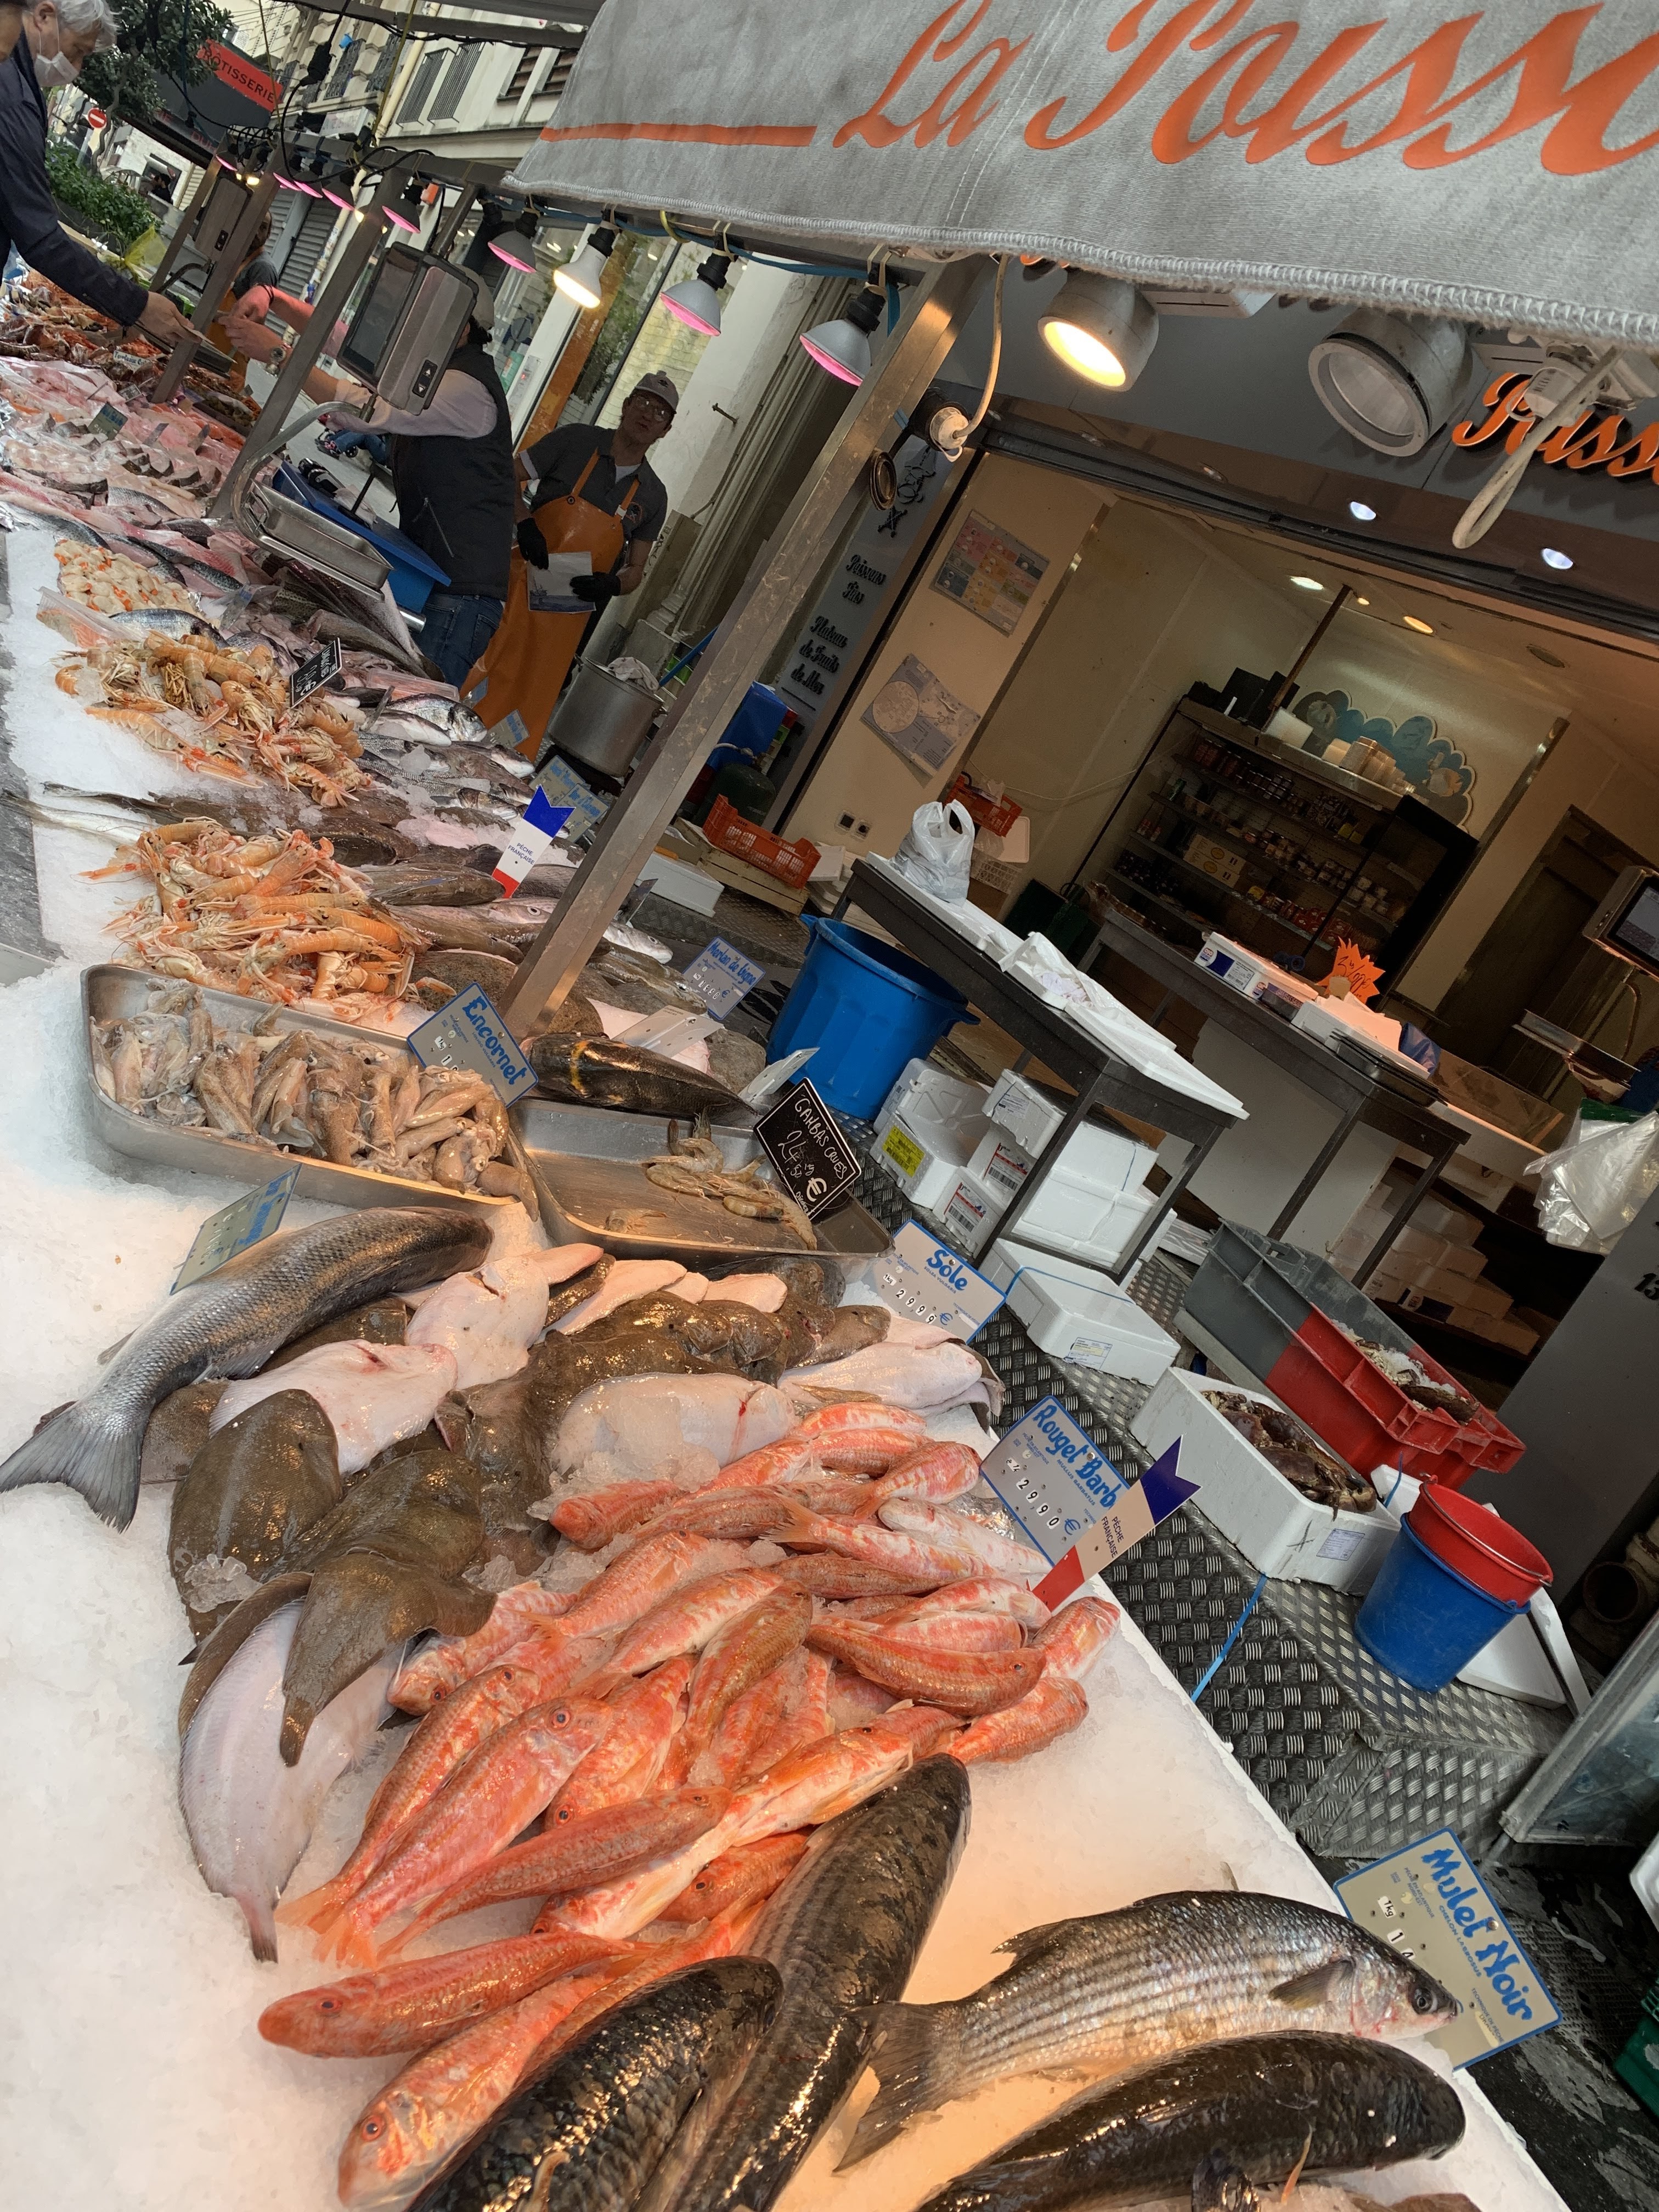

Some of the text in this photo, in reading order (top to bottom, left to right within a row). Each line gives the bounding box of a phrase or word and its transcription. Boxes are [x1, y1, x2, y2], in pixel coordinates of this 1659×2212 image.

[833, 0, 1034, 148] La
[847, 554, 887, 585] Poissons
[843, 581, 865, 604] Fins
[810, 616, 848, 648] Plateau
[799, 639, 839, 673] de Fruits
[791, 663, 825, 695] de Mer
[508, 845, 535, 865] FRANÇAISE
[517, 843, 533, 856] PÊCHE
[708, 941, 731, 966] Merlan
[729, 958, 741, 972] de
[722, 990, 730, 998] €
[462, 996, 527, 1085] Encornet
[795, 1098, 848, 1180] GAMBAS CRUES
[806, 1177, 827, 1202] €
[924, 1266, 956, 1294] SOLEA VULGARIS
[926, 1249, 968, 1291] Sole
[884, 1274, 893, 1283] 1kg
[939, 1313, 953, 1325] €
[1032, 1404, 1090, 1464] Rouget
[1075, 1457, 1121, 1509] Barb
[1033, 1445, 1049, 1465] ATLANTIQUE
[1057, 1459, 1096, 1506] MULLUS BARBATUS
[1064, 1518, 1081, 1536] €
[1101, 1516, 1118, 1558] FRANÇAISE
[1112, 1516, 1124, 1543] PÊCHE
[1404, 1866, 1435, 1918] PÊCHE EN ATLANTIQUE
[1407, 1882, 1424, 1906] NORD-EST
[1384, 1900, 1393, 1917] 1kg
[1421, 1848, 1532, 2021] Mulet Noir
[1440, 1905, 1482, 1978] CHELON LABROSUS
[1471, 1987, 1506, 2044] TECHNIQUE DE PÊCHE
